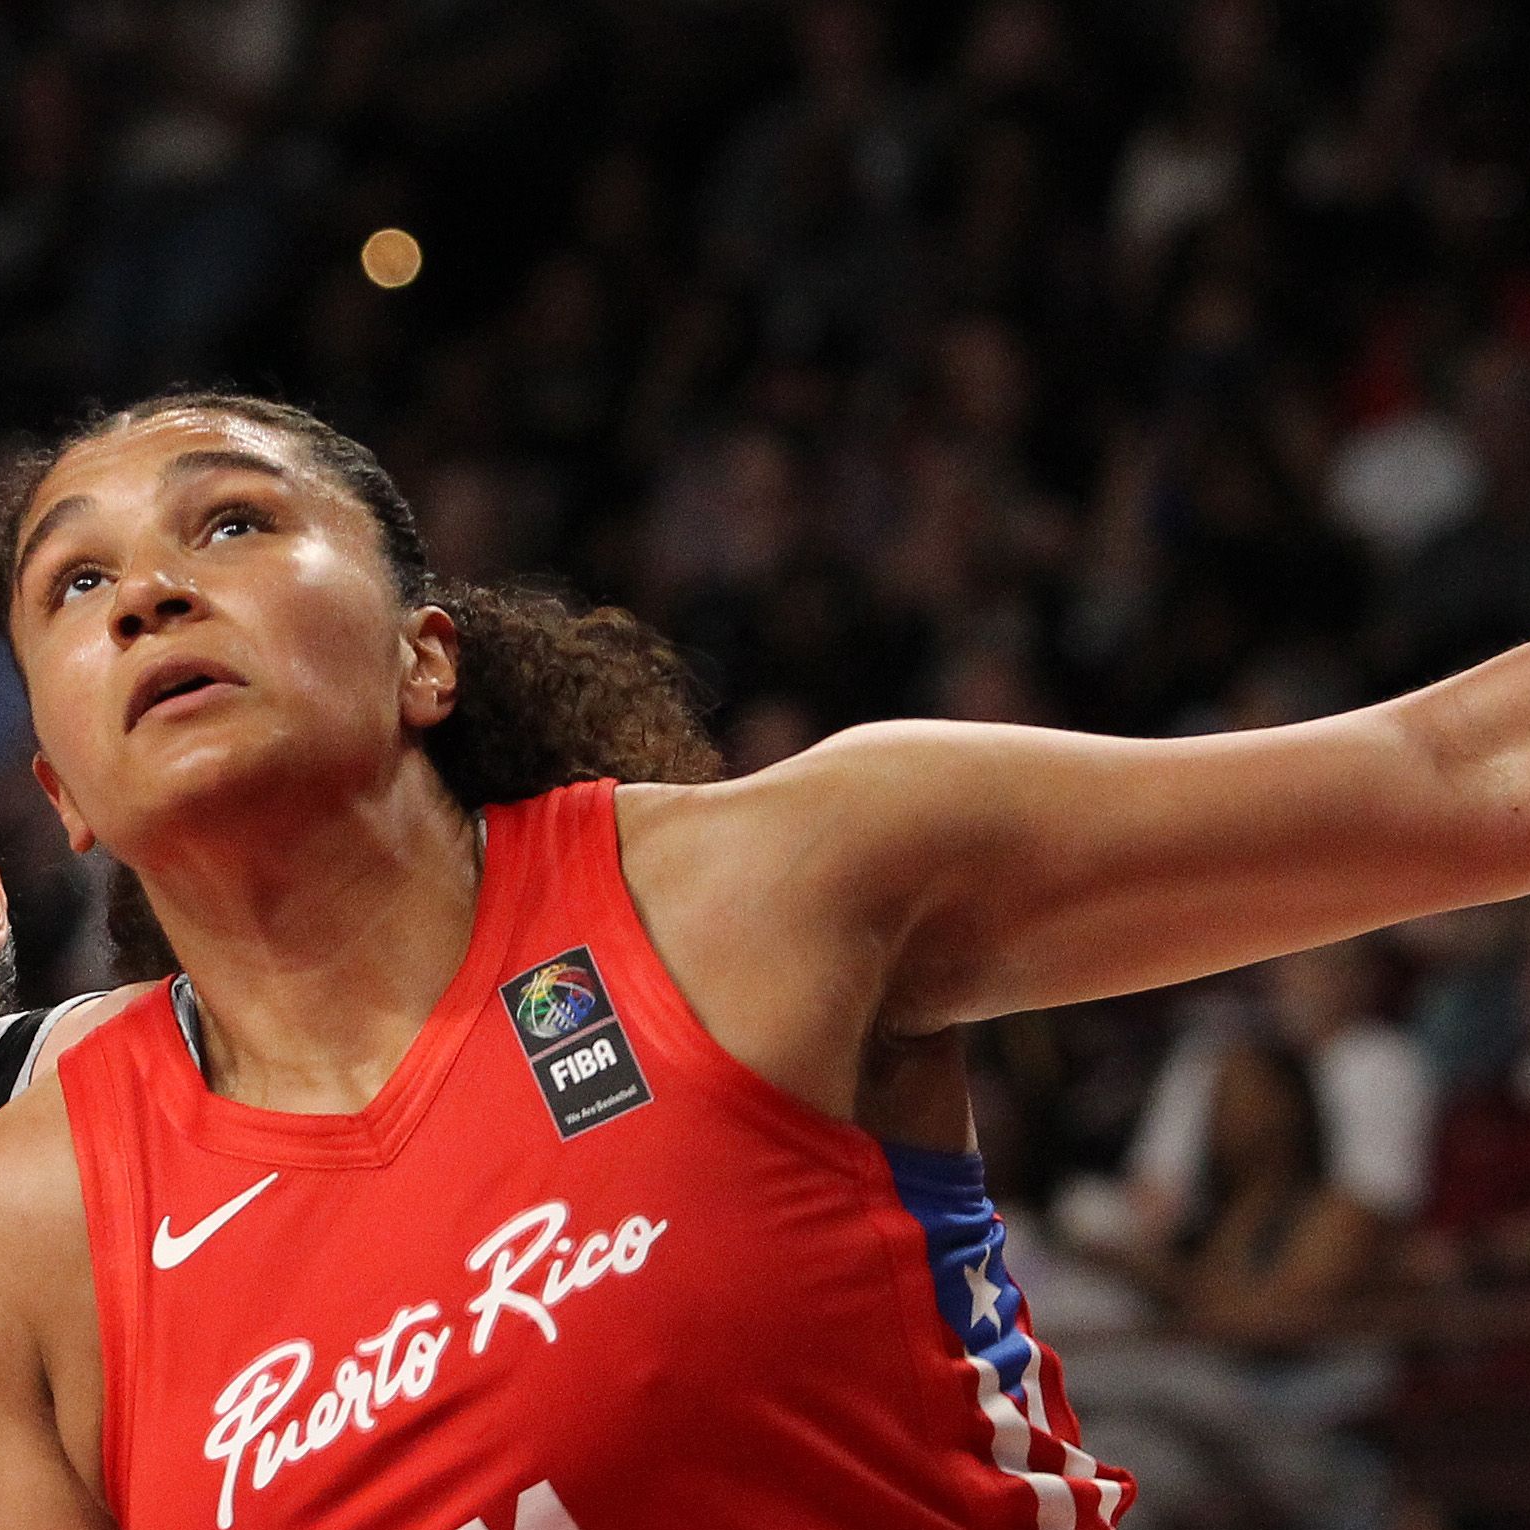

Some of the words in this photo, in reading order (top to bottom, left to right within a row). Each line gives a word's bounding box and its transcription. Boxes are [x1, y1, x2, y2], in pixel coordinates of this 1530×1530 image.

[549, 1037, 618, 1092] FIBA
[204, 1301, 452, 1530] Puerto
[466, 1200, 668, 1354] Rico
